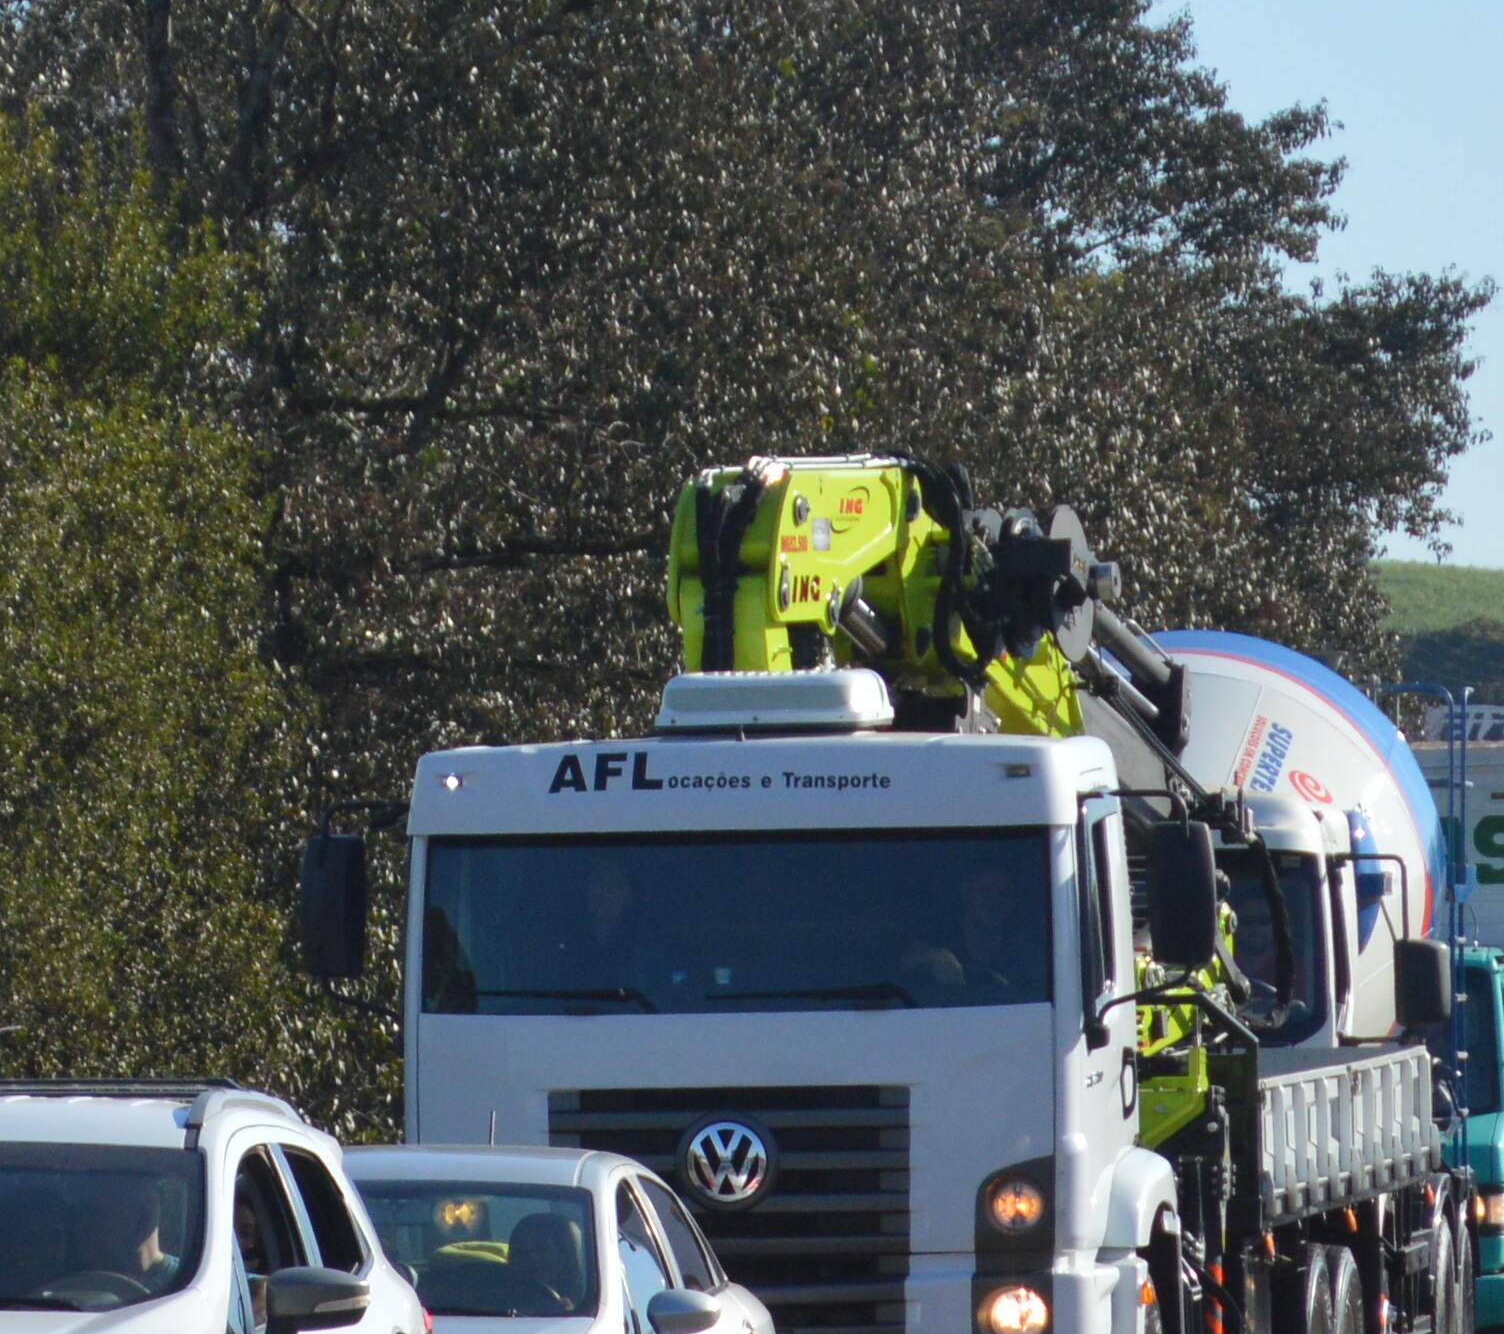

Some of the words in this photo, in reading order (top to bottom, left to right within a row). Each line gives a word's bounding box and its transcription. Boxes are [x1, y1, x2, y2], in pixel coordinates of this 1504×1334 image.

[839, 498, 863, 514] ING
[792, 575, 821, 603] ING
[760, 776, 772, 789] e
[782, 771, 891, 791] Transporte
